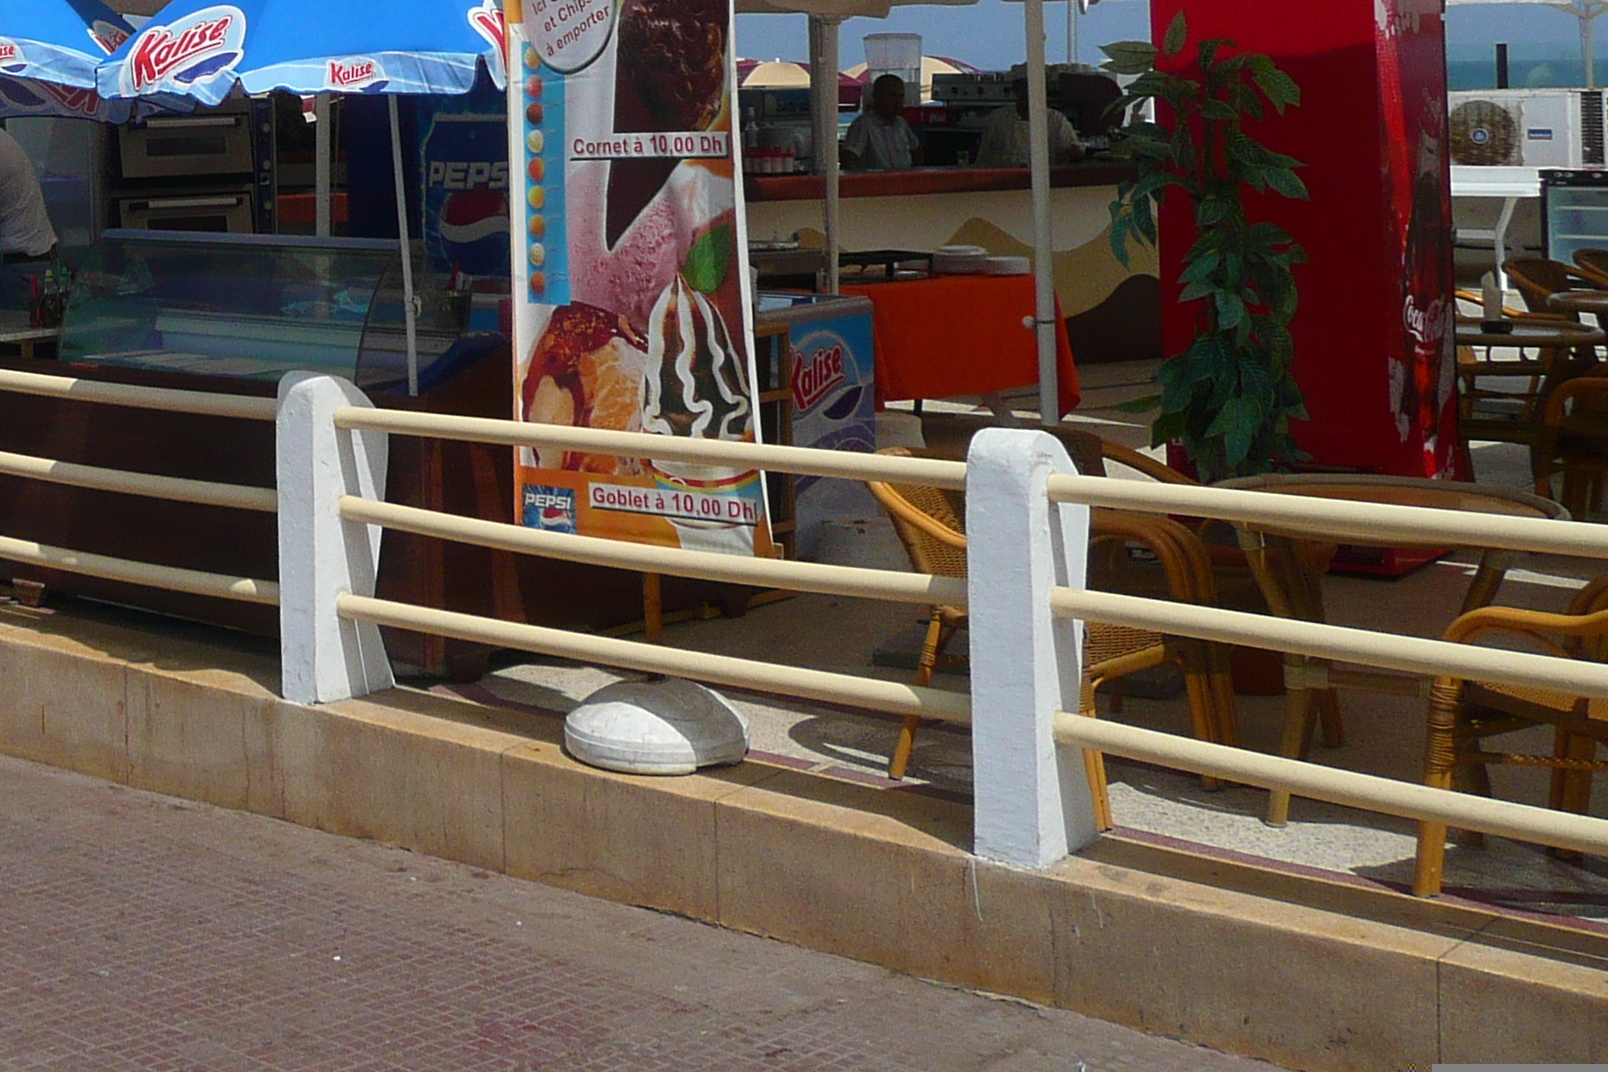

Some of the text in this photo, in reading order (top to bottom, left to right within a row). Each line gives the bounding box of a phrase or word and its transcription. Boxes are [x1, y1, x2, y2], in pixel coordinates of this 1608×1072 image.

[544, 16, 558, 32] et
[546, 5, 610, 56] à emporter
[131, 15, 233, 90] Kalise
[331, 60, 373, 86] Kalise
[573, 134, 722, 154] Cornet à 10,00 Dh
[430, 161, 508, 189] PEPS
[524, 493, 570, 510] PEPSI
[592, 487, 755, 520] Goblet à 10,00 Dh
